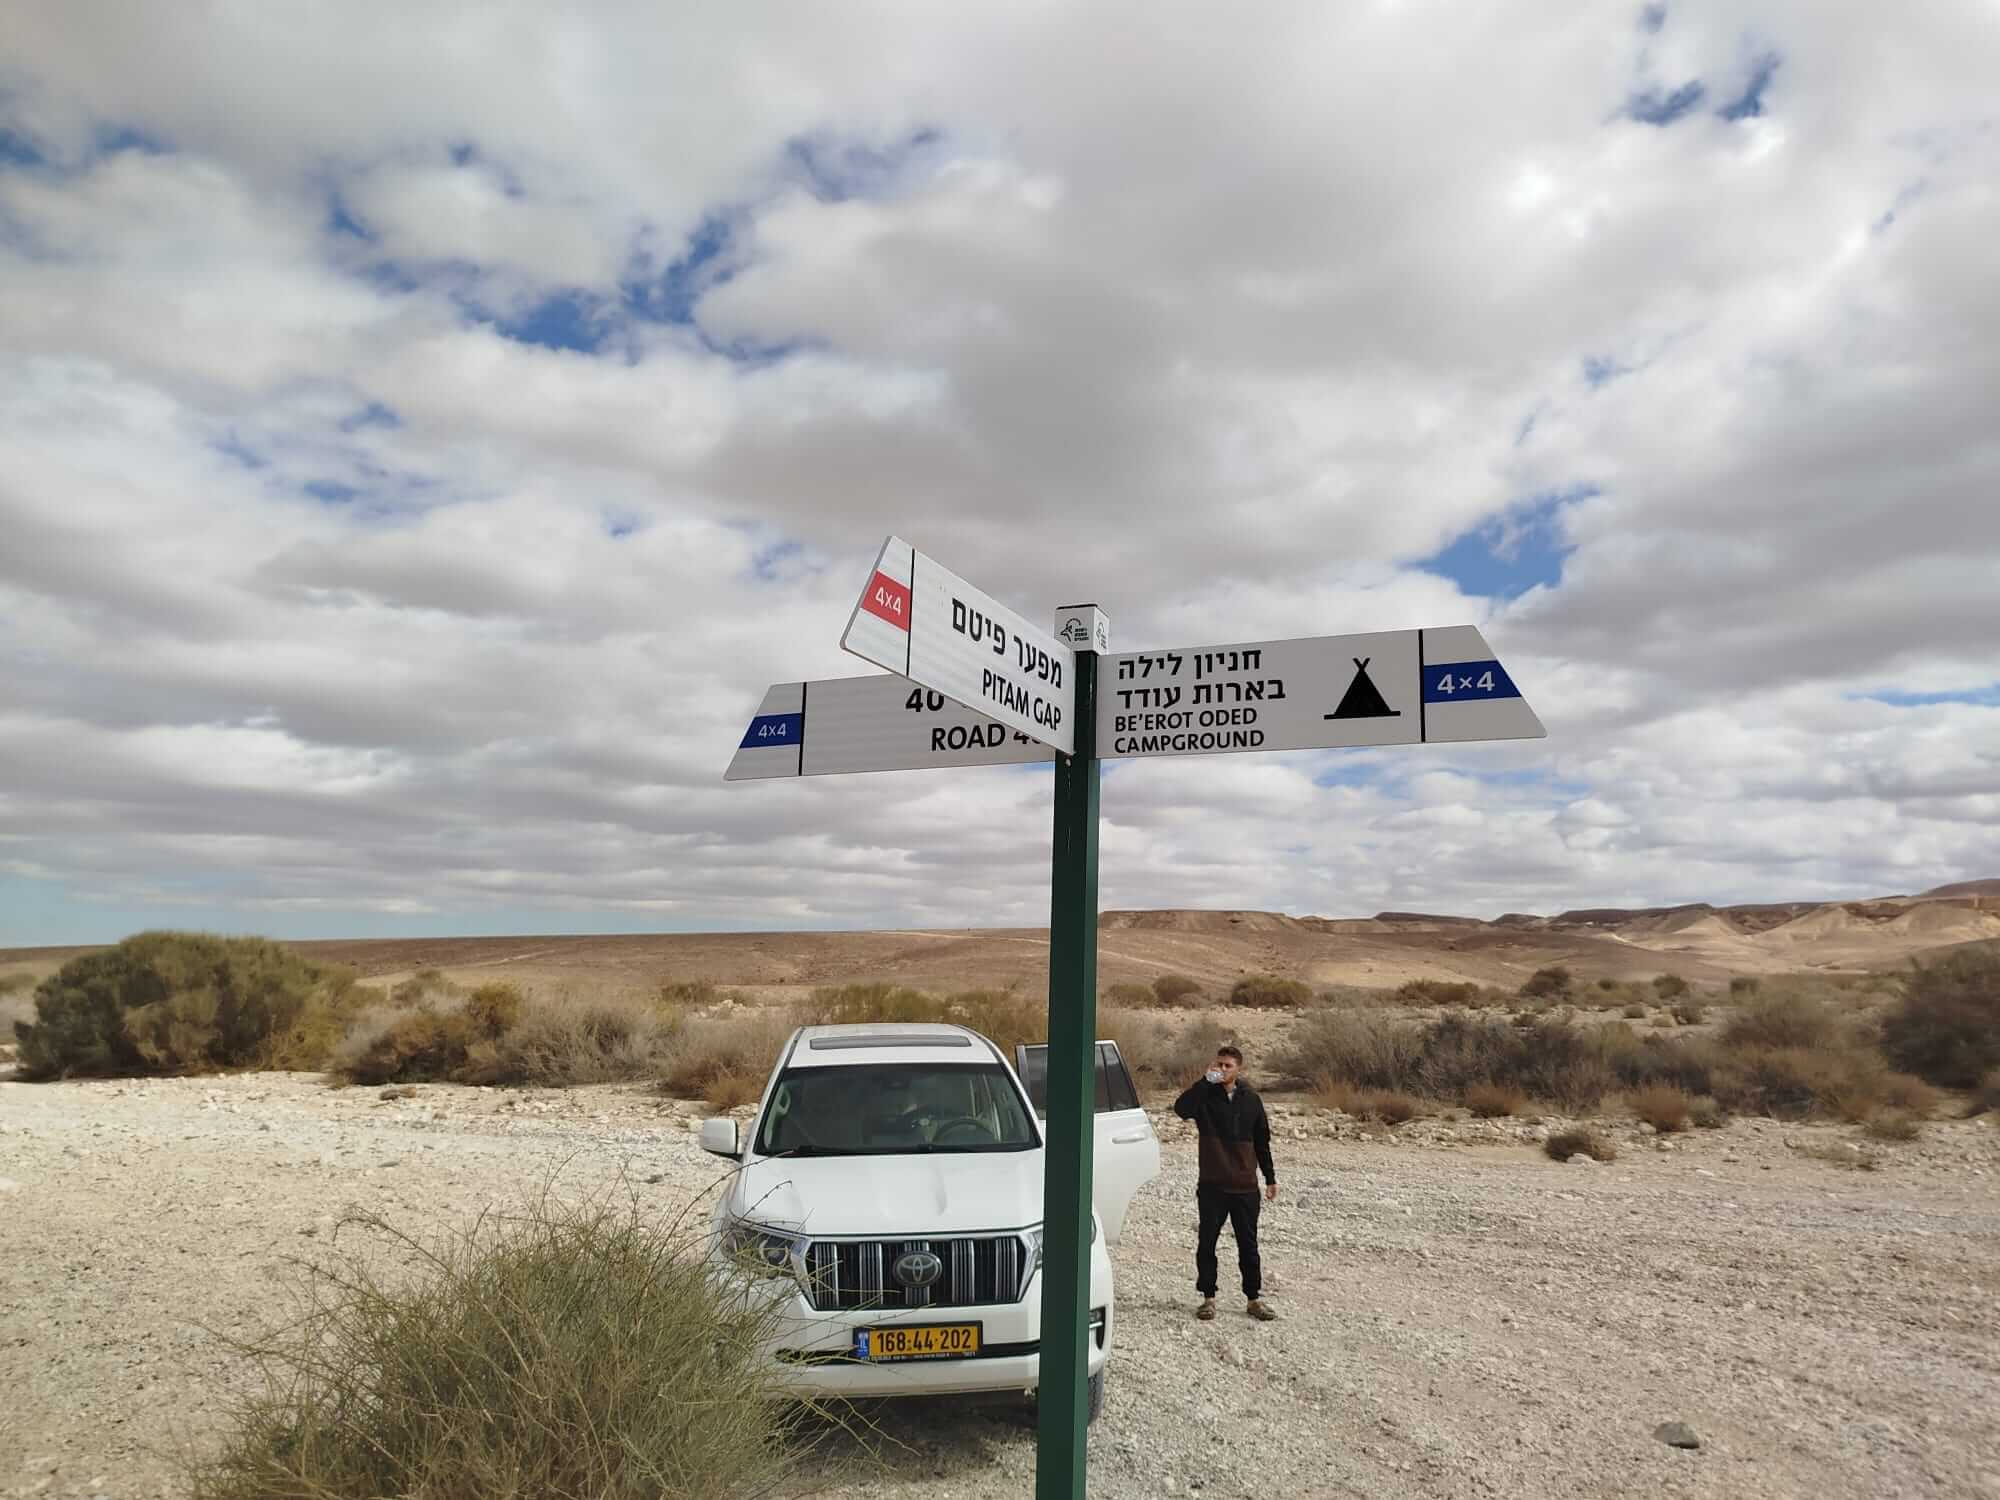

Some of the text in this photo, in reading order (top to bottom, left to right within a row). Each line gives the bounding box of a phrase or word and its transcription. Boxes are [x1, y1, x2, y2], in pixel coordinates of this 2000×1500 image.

[952, 597, 1062, 689] מפער פיטם
[1118, 650, 1262, 680] חניון לילה
[905, 688, 945, 713] 40
[983, 668, 1062, 731] PITAM GAP
[1117, 679, 1286, 709] בארות עודד
[1115, 708, 1258, 732] BE'EROT ODED
[931, 724, 1006, 751] ROAD
[1114, 730, 1265, 753] CAMPGROUND
